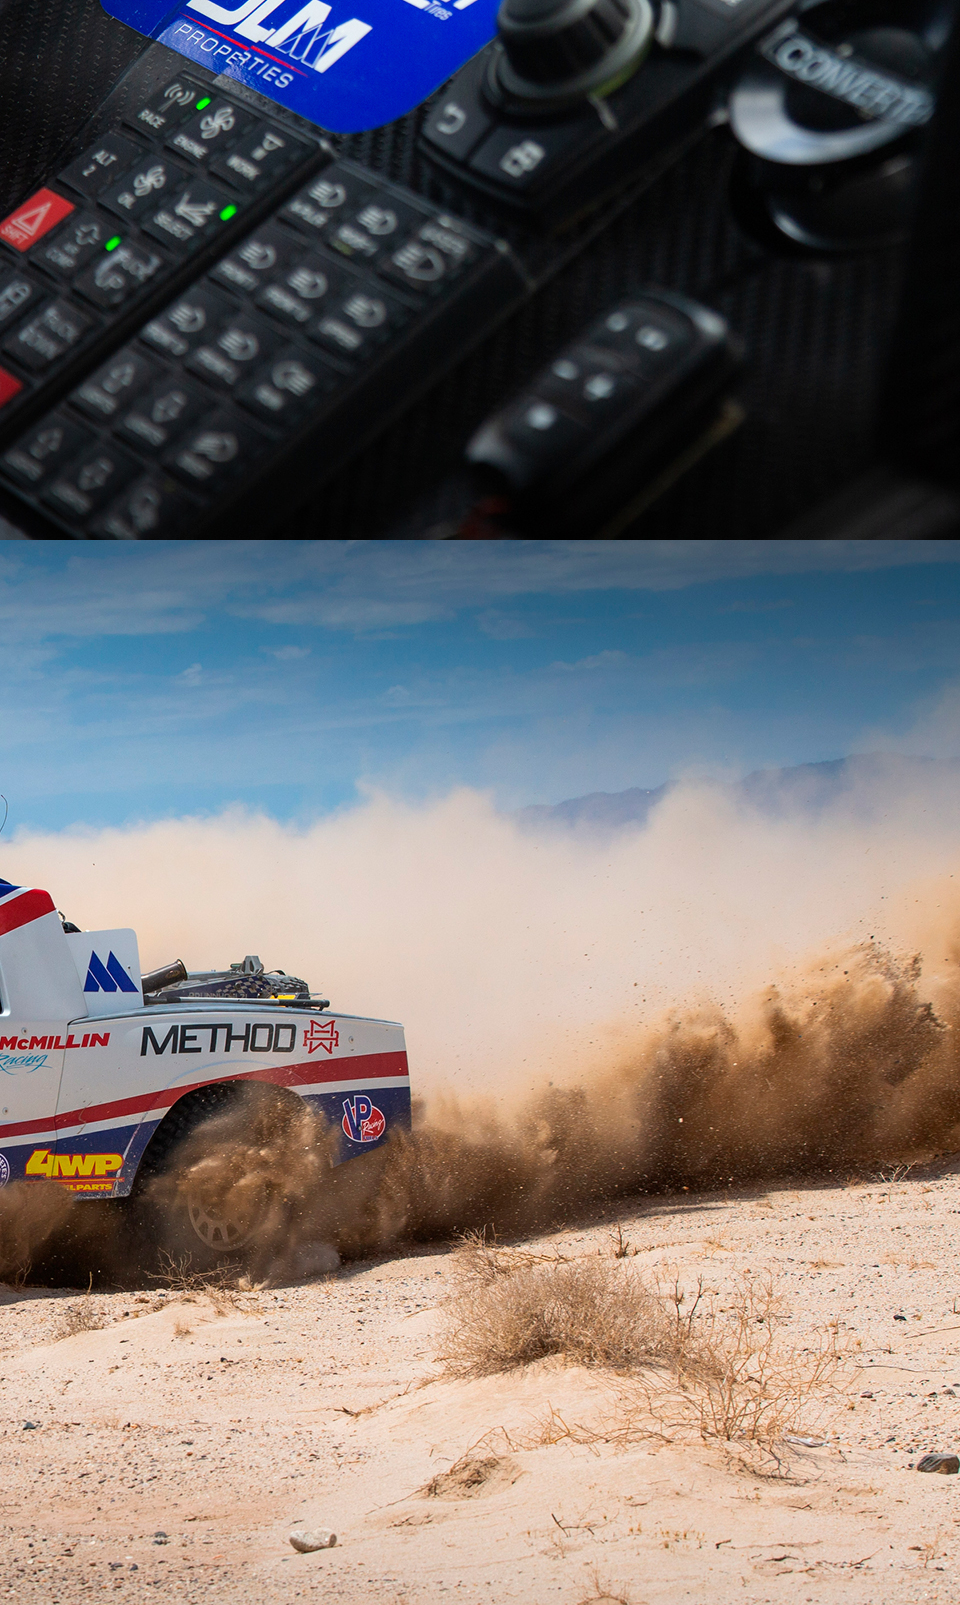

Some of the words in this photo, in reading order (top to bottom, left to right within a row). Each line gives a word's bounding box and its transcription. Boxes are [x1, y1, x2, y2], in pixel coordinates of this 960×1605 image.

[174, 22, 295, 89] PROPERTIES
[138, 108, 166, 129] RACE
[92, 149, 118, 167] ALT
[173, 134, 208, 159] ENGINE
[140, 1022, 297, 1057] METHOD
[25, 1149, 125, 1178] 4WP
